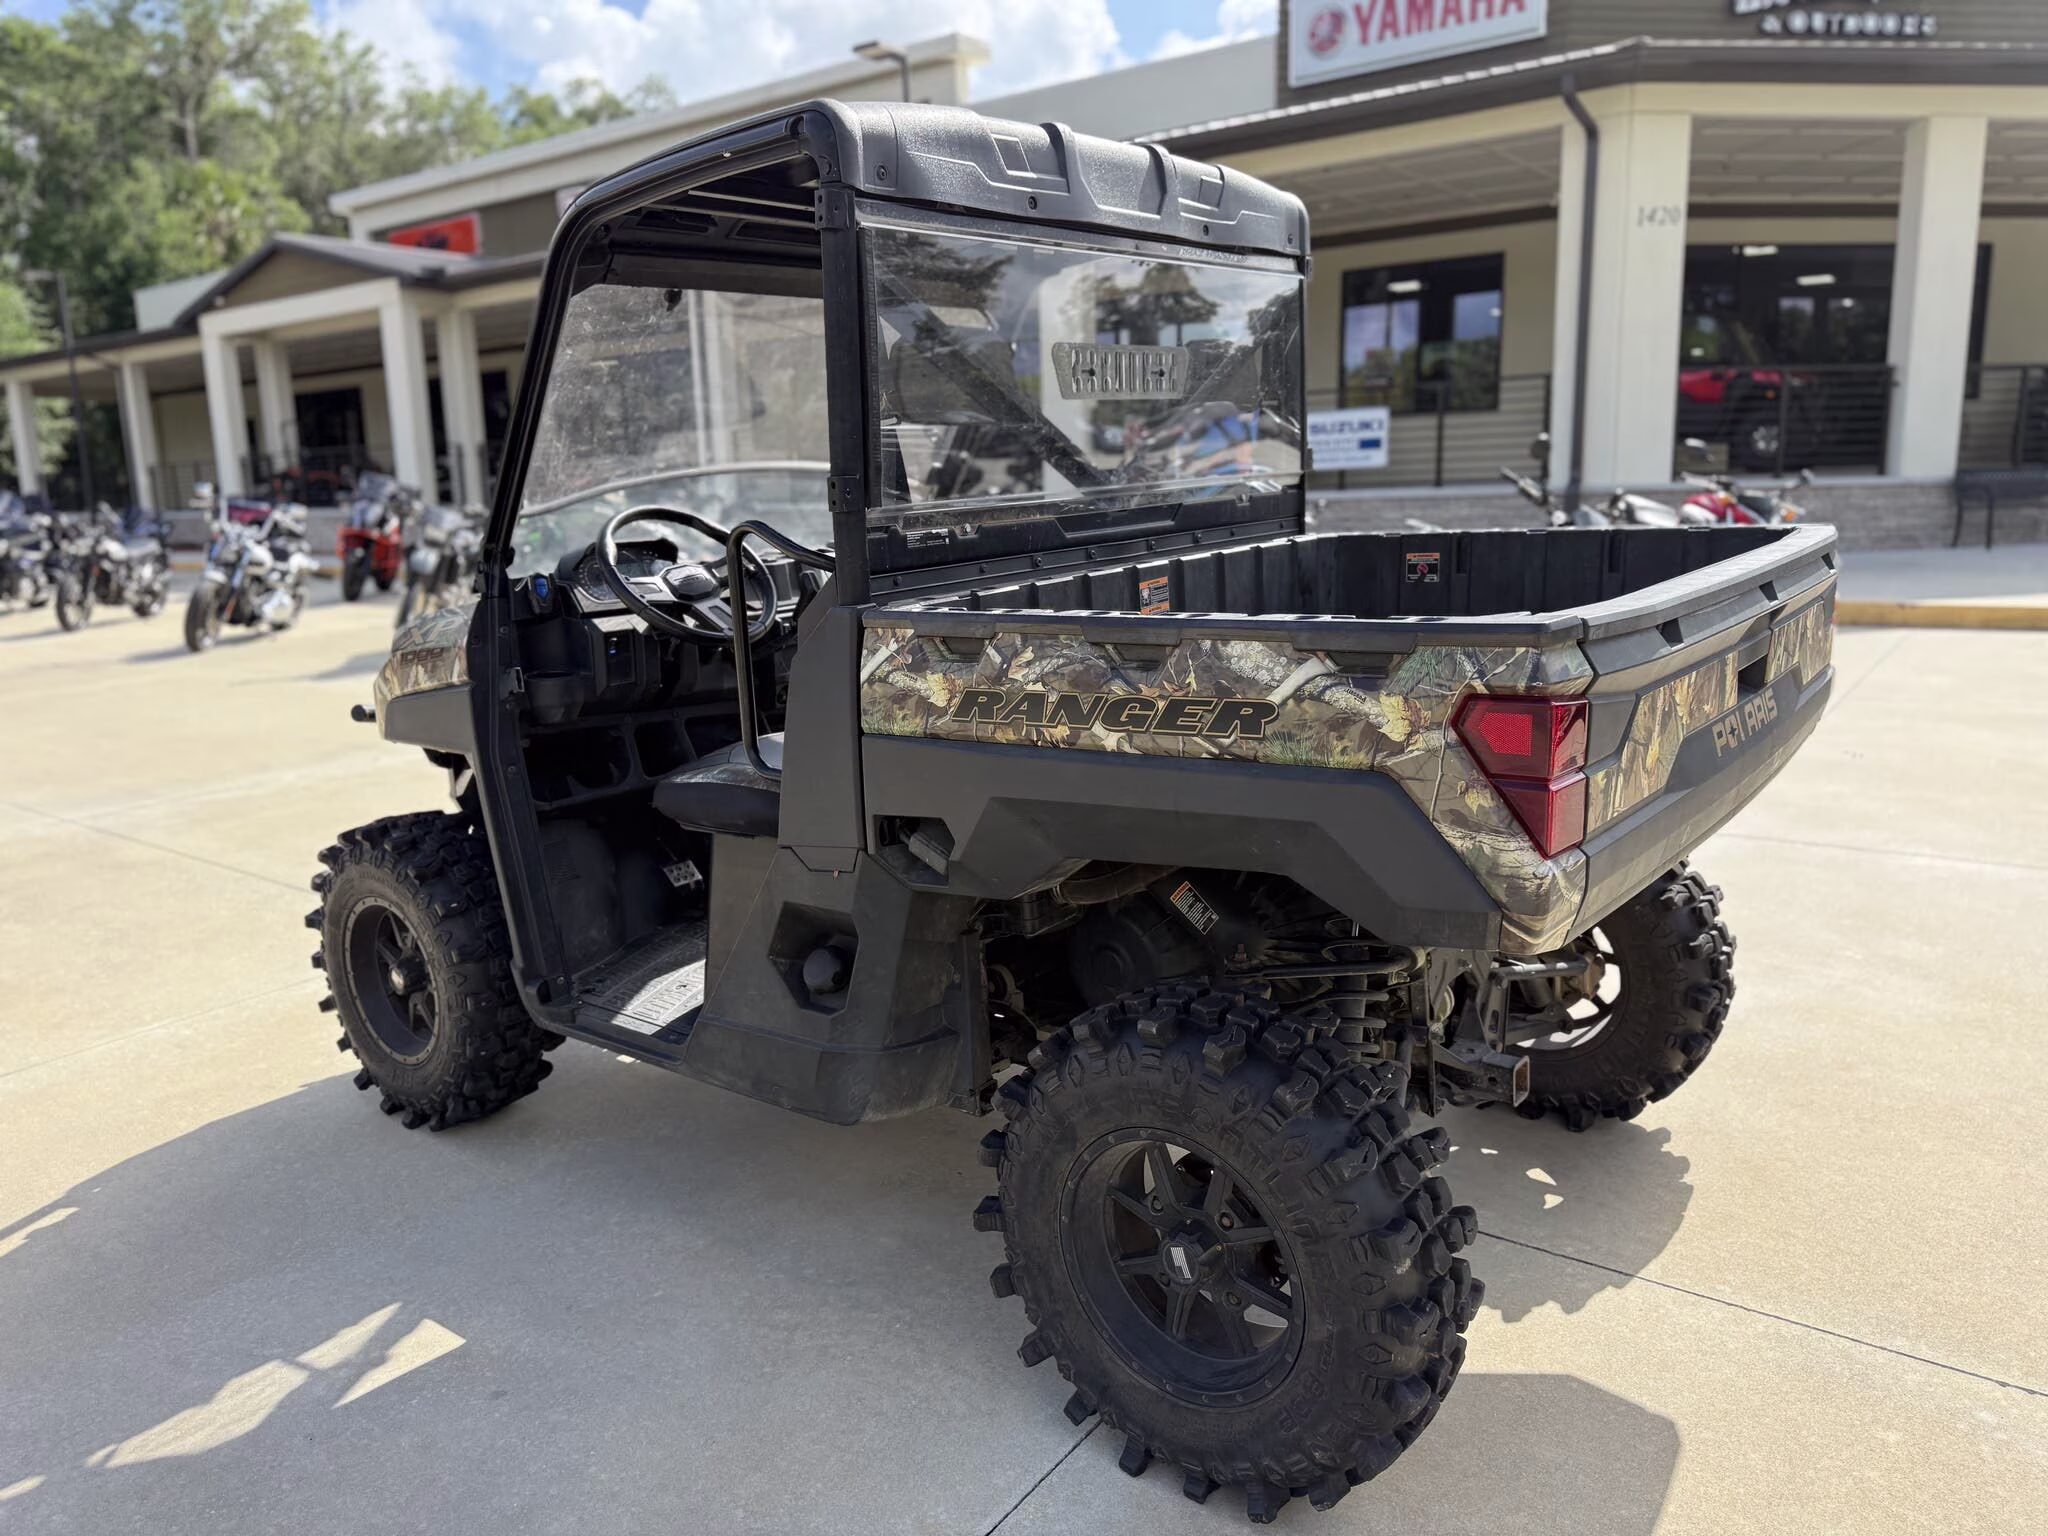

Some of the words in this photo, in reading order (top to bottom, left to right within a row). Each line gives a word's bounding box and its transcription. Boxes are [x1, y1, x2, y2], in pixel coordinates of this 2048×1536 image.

[1637, 205, 1681, 227] 1420
[1309, 420, 1384, 436] SUZUKI
[951, 688, 1279, 738] RANGER
[1712, 687, 1778, 757] POLARIS
